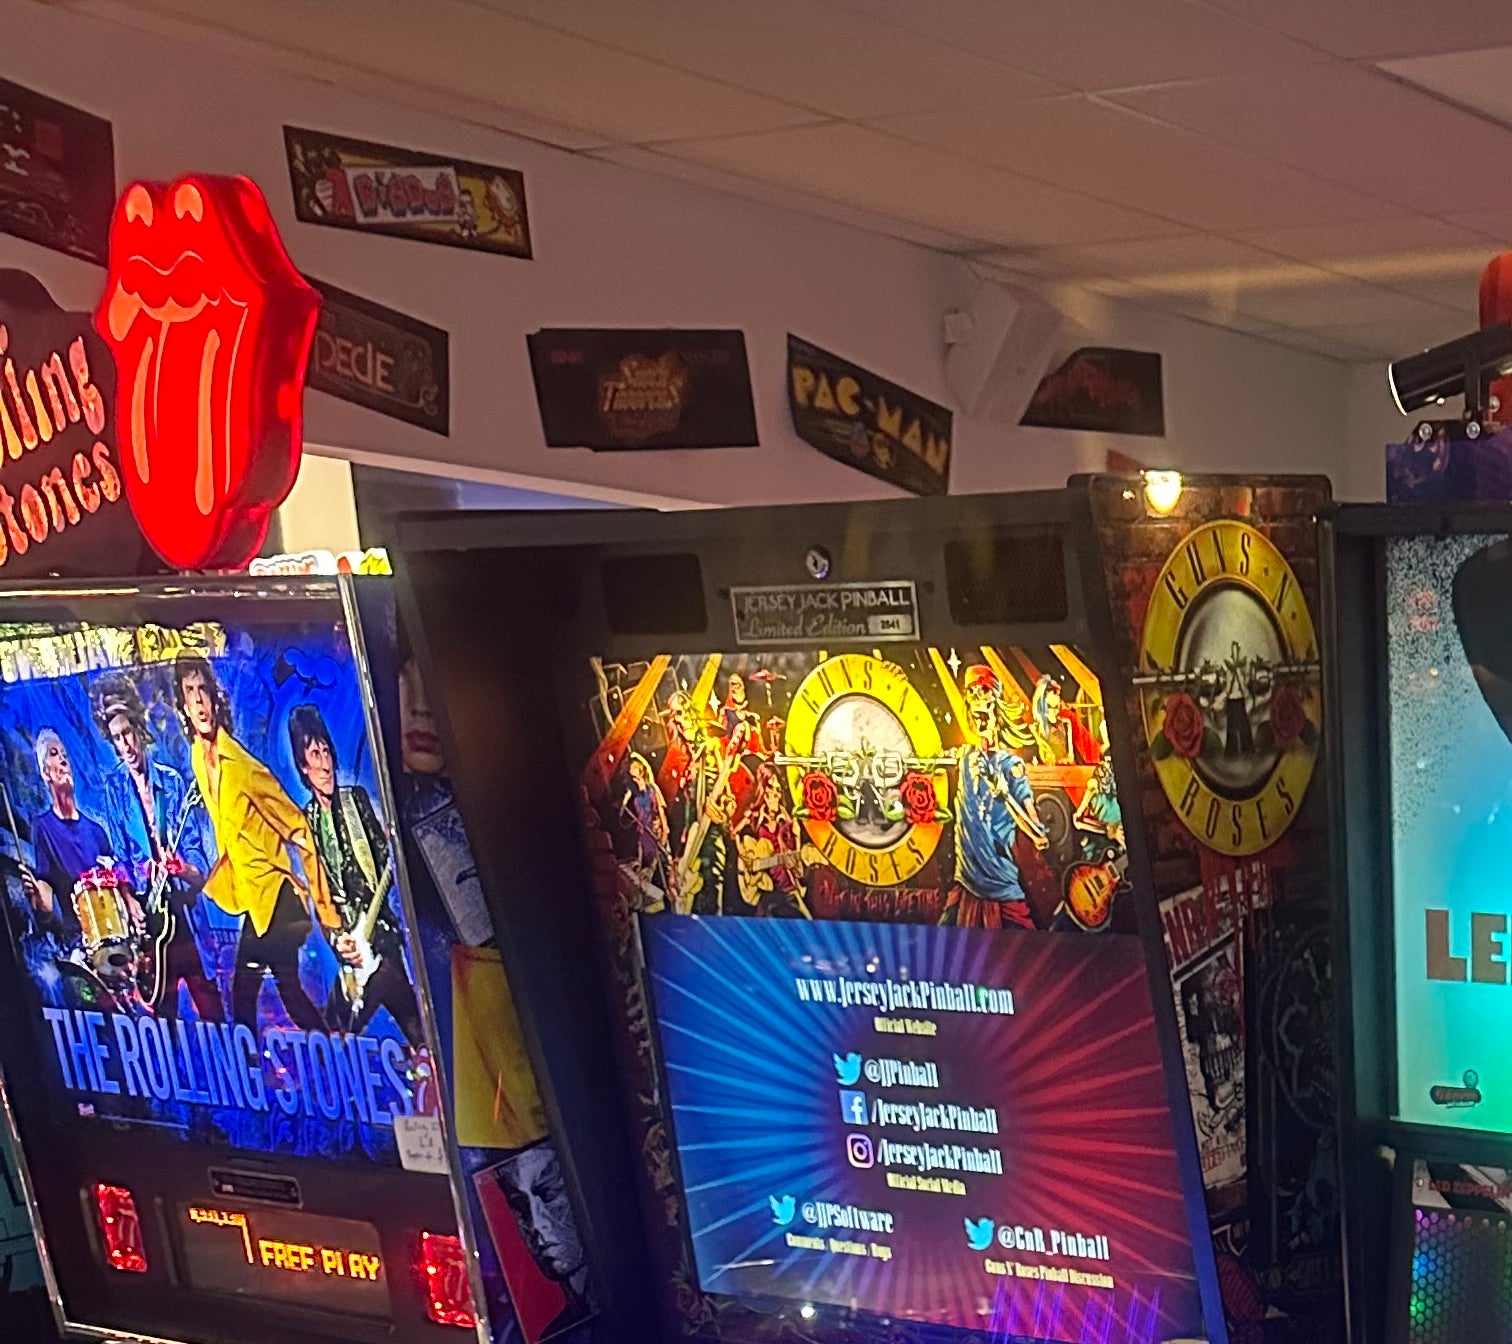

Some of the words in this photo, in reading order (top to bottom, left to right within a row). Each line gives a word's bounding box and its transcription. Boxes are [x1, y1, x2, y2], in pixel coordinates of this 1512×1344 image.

[0, 336, 105, 468] lling
[791, 365, 948, 475] PAC-MAN
[0, 441, 120, 567] tones
[744, 594, 796, 614] JERSEY
[798, 592, 838, 613] JACK
[841, 589, 910, 611] PINBALL
[744, 613, 804, 638] Limited
[806, 613, 866, 637] Edition
[1181, 774, 1294, 846] ROSES
[823, 832, 925, 884] ROSES
[795, 976, 1015, 1015] www.JerseyJackPinball.com
[43, 1007, 121, 1094] THE
[112, 1012, 270, 1112] ROLLING
[263, 1027, 414, 1126] STONES
[864, 1058, 939, 1088] @JJPinball
[871, 1098, 999, 1134] /JerseyJackPinball
[877, 1138, 1003, 1175] /JerseyJackPinball
[801, 1201, 895, 1234] @JJPSoftware
[258, 1239, 315, 1271] FREE
